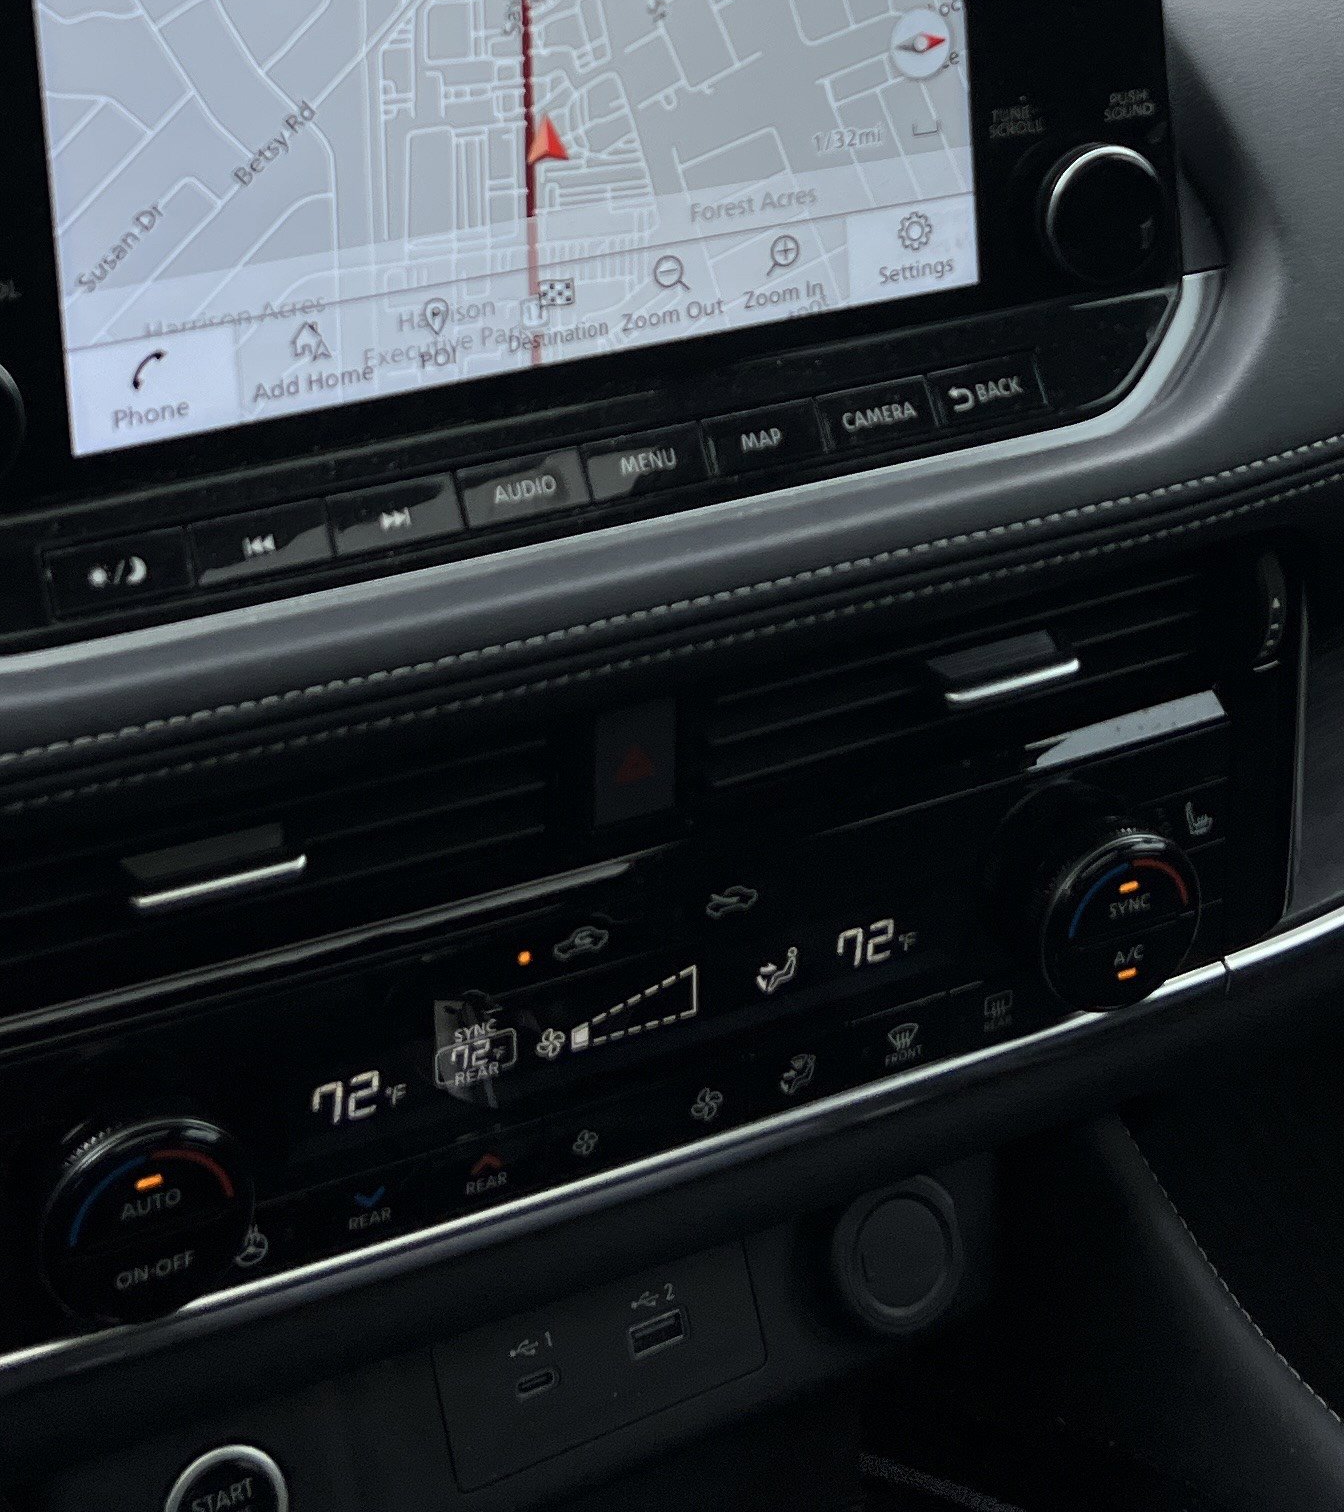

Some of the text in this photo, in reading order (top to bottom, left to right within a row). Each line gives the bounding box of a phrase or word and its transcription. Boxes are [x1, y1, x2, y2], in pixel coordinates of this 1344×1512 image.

[233, 100, 317, 187] Betsy Rd
[690, 187, 817, 223] Forest Acres
[78, 203, 164, 293] Susan Dr
[879, 258, 954, 285] Settings
[743, 287, 800, 310] Zoom
[806, 281, 824, 300] In
[622, 296, 725, 332] Zoom Out
[508, 318, 609, 354] Destination
[254, 363, 375, 403] Add Home
[974, 375, 1022, 401] BACK
[113, 399, 190, 432] Phone
[841, 399, 917, 431] CAMERA
[740, 428, 782, 452] MAP
[619, 447, 677, 476] MENU
[493, 474, 557, 504] AUDIO
[1108, 893, 1152, 920] SYNC
[1113, 944, 1145, 967] A/C
[454, 1018, 497, 1043] SYNC
[455, 1061, 500, 1087] REAR
[466, 1171, 508, 1196] REAR
[119, 1188, 182, 1222] AUTO
[348, 1207, 392, 1231] REAR
